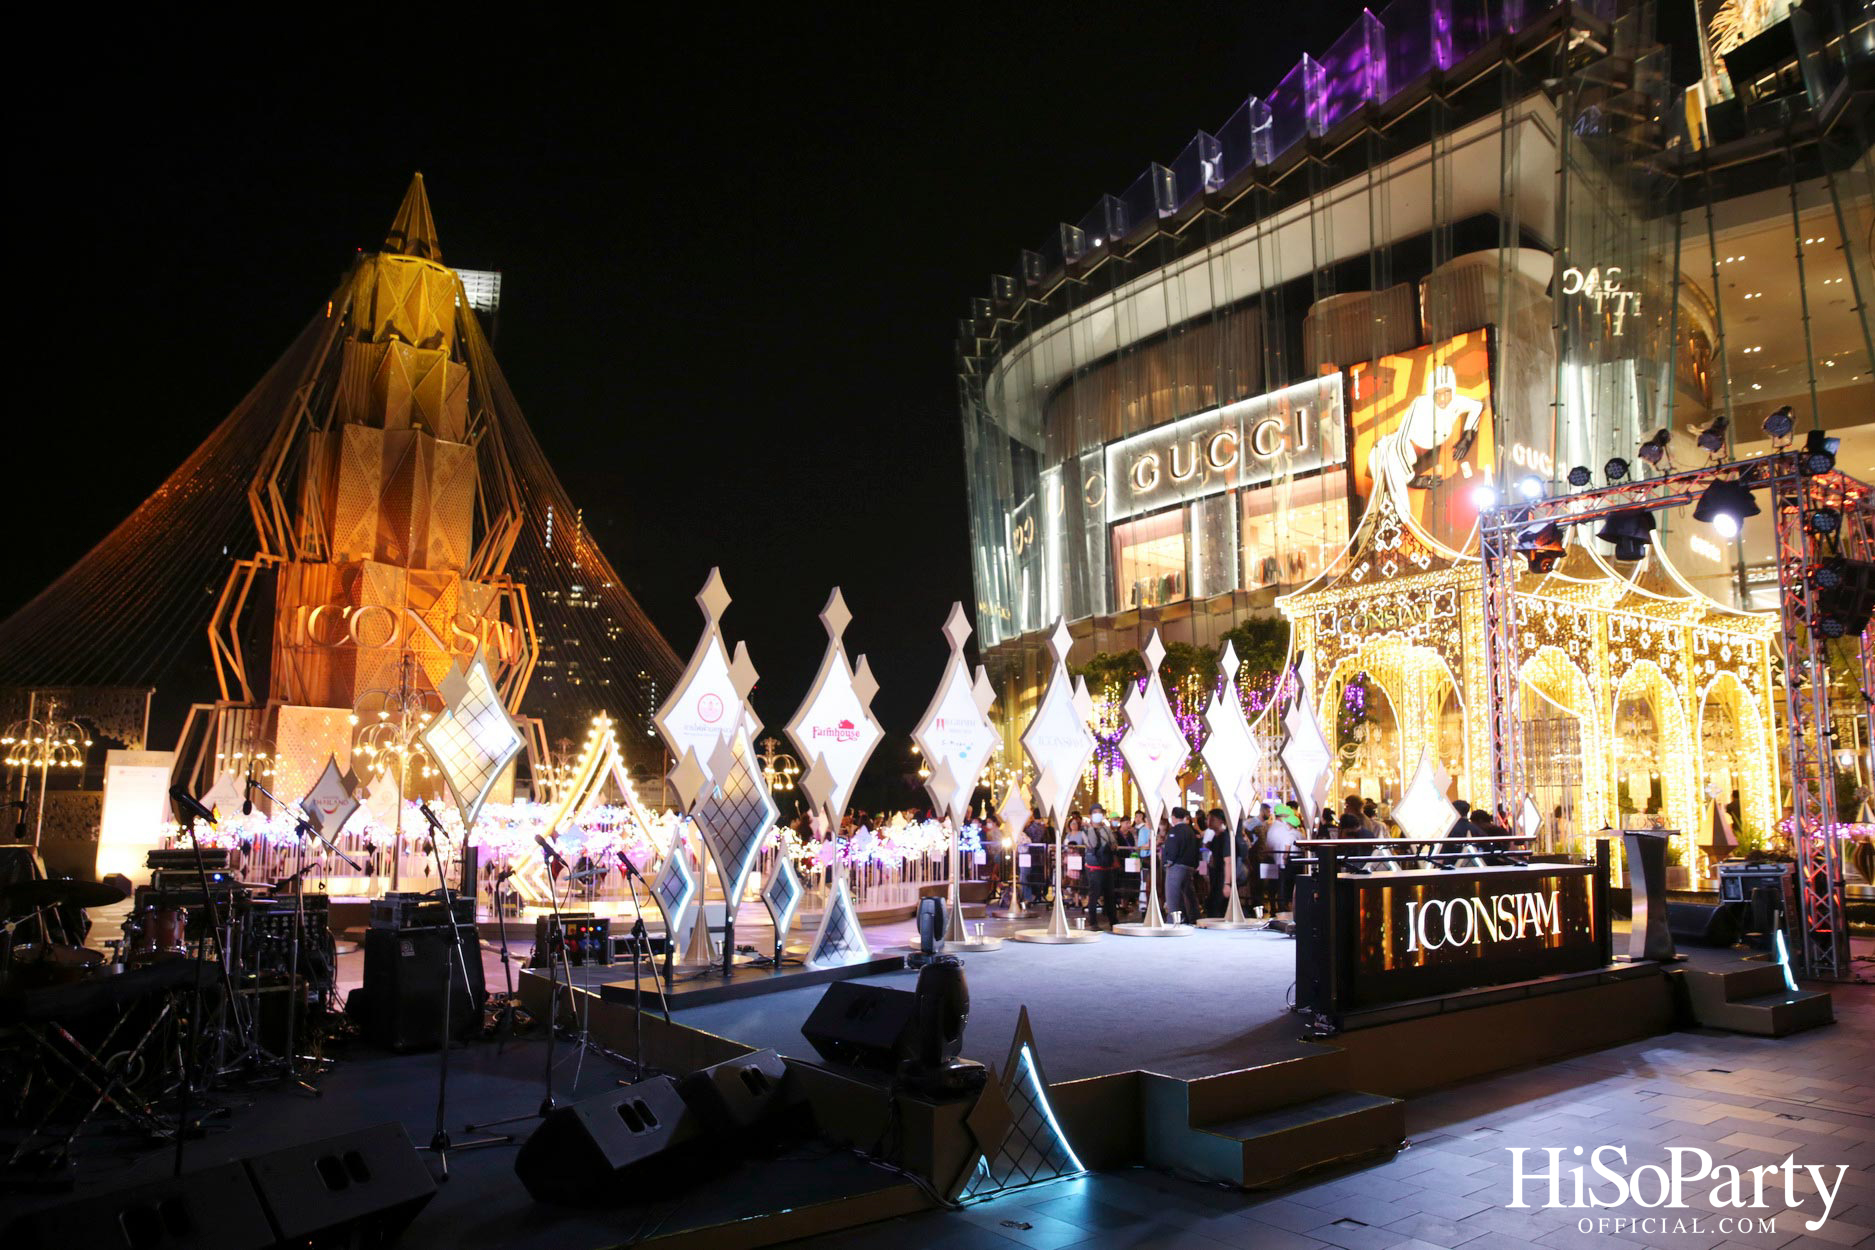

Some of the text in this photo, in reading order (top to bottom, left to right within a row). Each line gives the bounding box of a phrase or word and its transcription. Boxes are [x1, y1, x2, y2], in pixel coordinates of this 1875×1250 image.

[1133, 407, 1308, 490] GUCCI
[812, 725, 861, 742] Farmhouse
[1406, 890, 1562, 952] ICONSIAM
